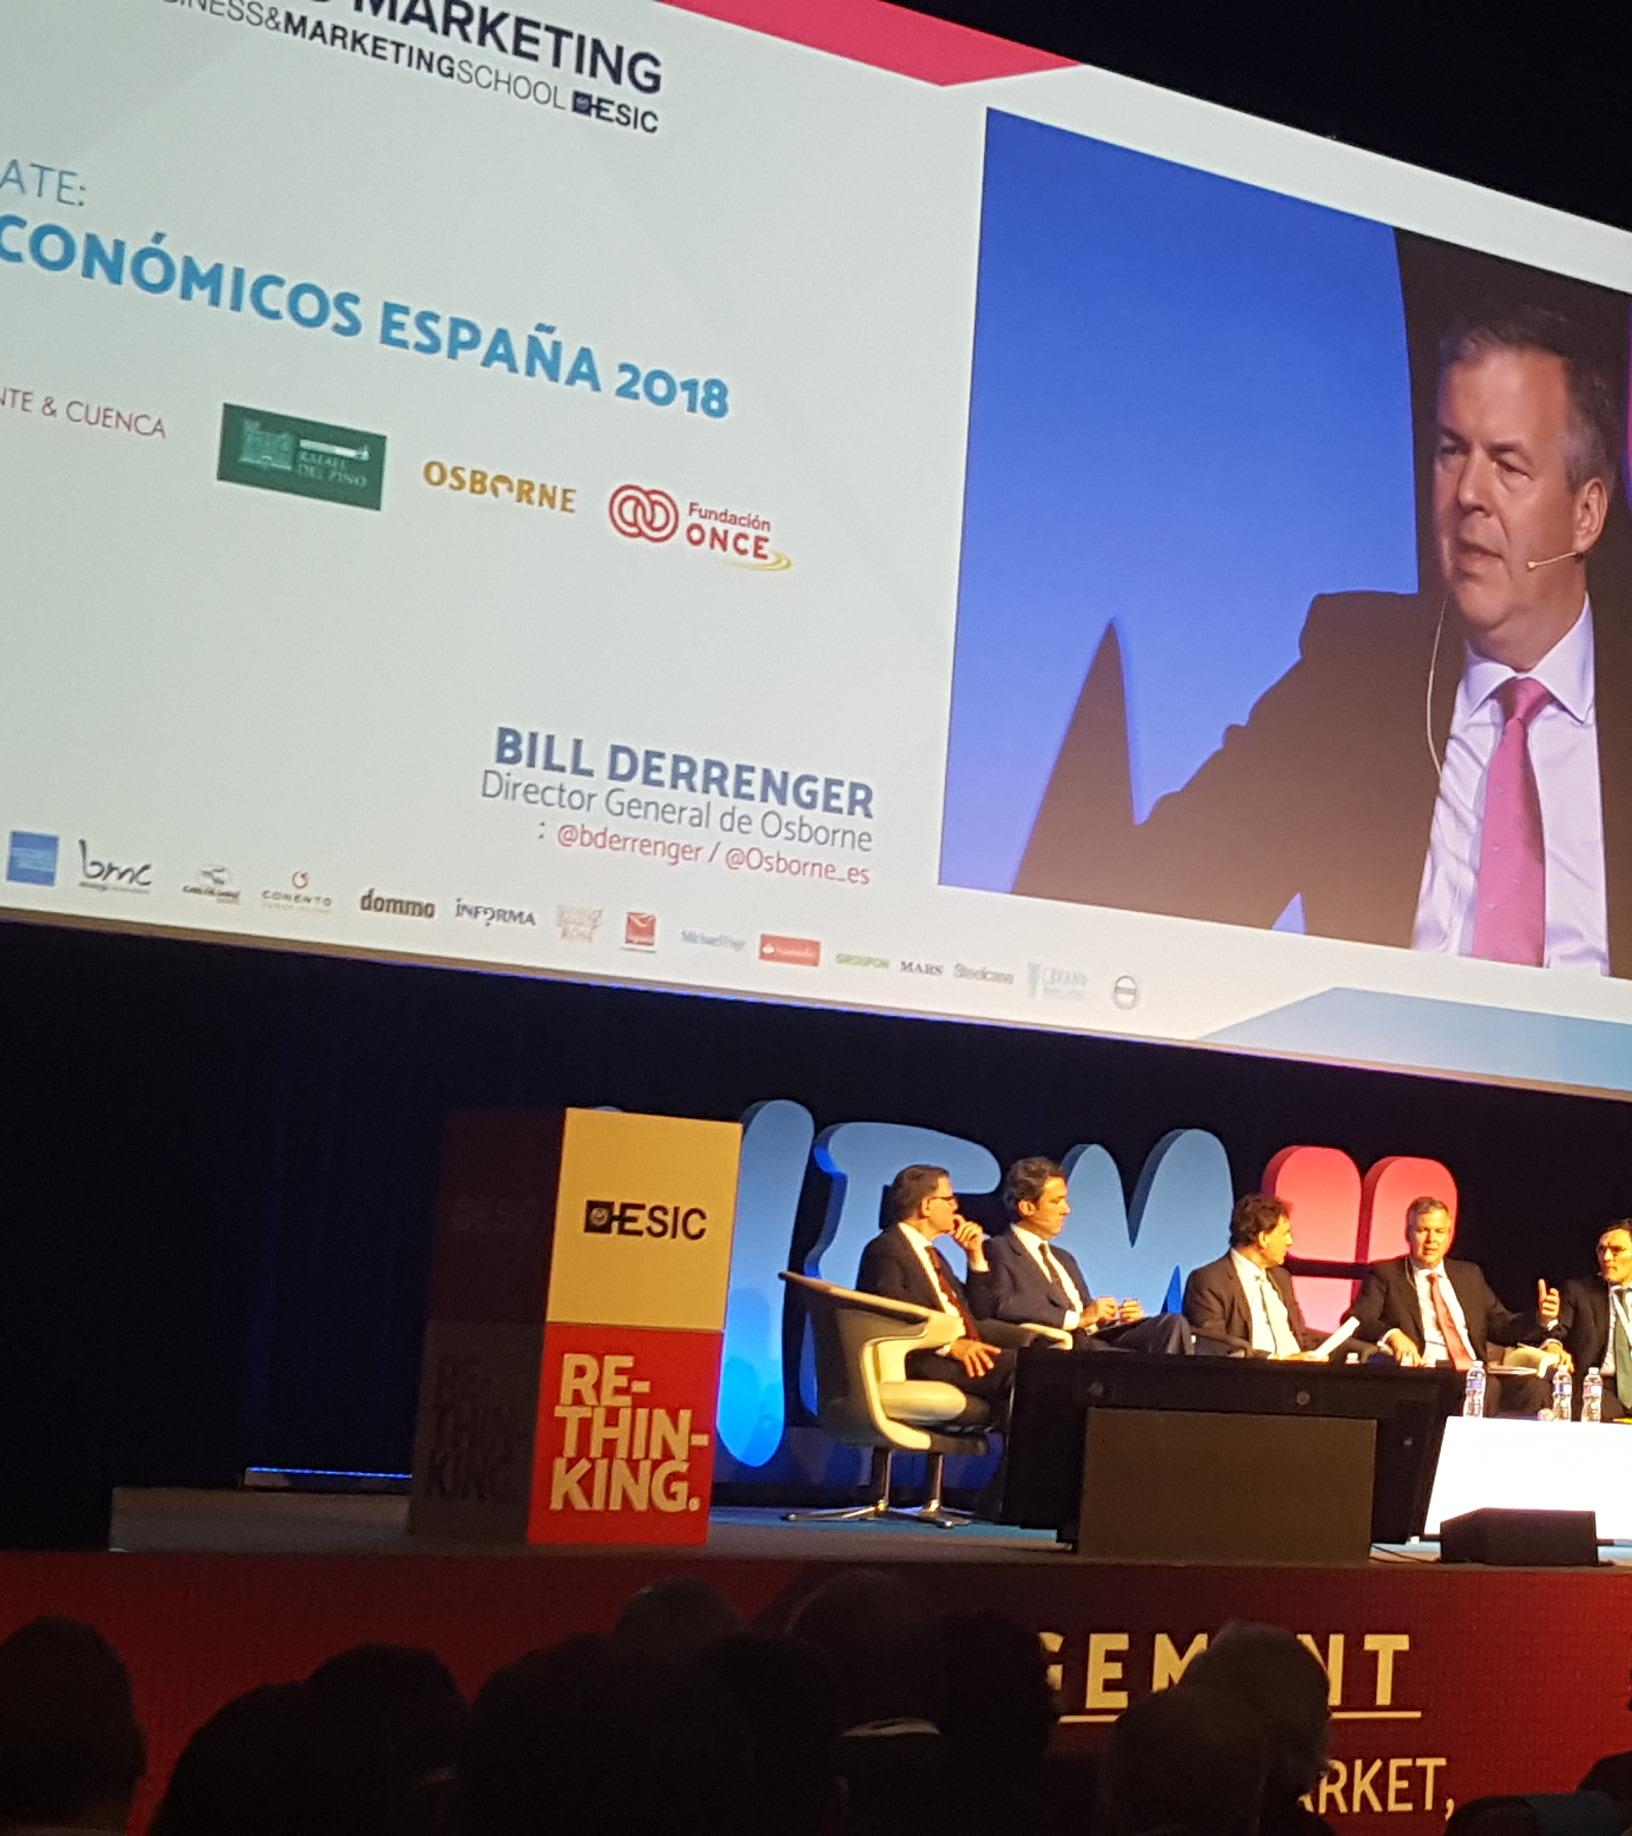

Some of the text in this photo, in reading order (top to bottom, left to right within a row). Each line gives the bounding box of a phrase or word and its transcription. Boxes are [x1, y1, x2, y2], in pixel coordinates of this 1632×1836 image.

[596, 97, 660, 135] ESIC
[0, 158, 87, 207] ATE:
[0, 214, 731, 419] CONÓMICOS ESPAÑA 2018
[41, 396, 57, 418] &
[65, 400, 167, 439] CUENCA
[423, 460, 577, 514] OSBORNE
[685, 523, 770, 560] ONCE
[687, 502, 772, 532] Fundación
[494, 726, 875, 820] BILL DERRENGER
[481, 768, 873, 852] Director General de Osborne
[557, 824, 704, 866] @bderrenger
[725, 846, 871, 886] @Osborne_es
[616, 1202, 708, 1242] ESIC
[560, 1352, 651, 1408] RE-
[554, 1405, 710, 1462] THIN-
[549, 1456, 701, 1514] KING.
